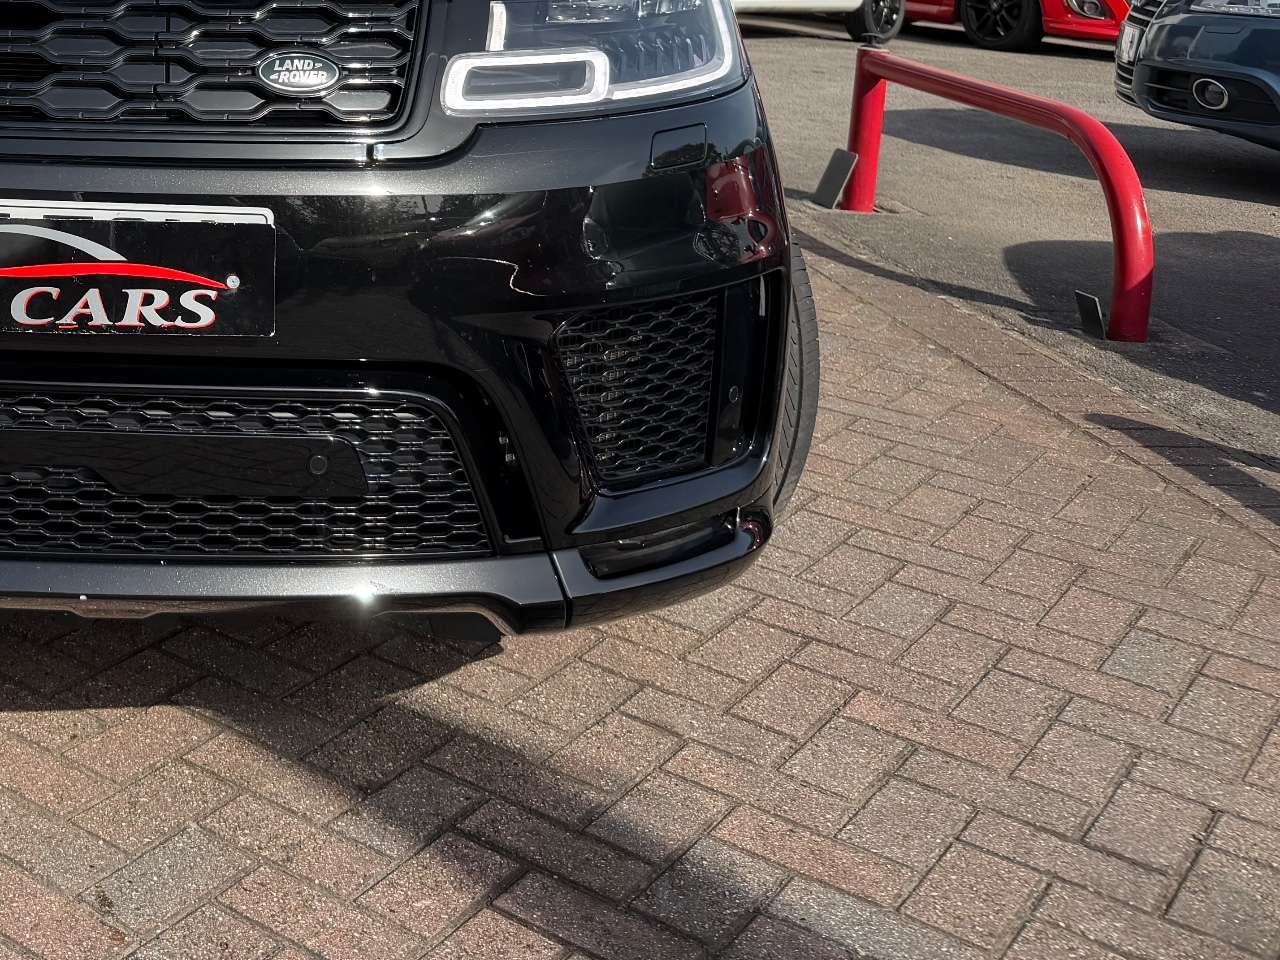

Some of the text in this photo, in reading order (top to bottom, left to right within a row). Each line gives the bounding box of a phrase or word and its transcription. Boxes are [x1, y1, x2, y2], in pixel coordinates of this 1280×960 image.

[273, 59, 314, 70] LAND
[278, 70, 328, 83] ROVER
[10, 286, 218, 328] CARS
